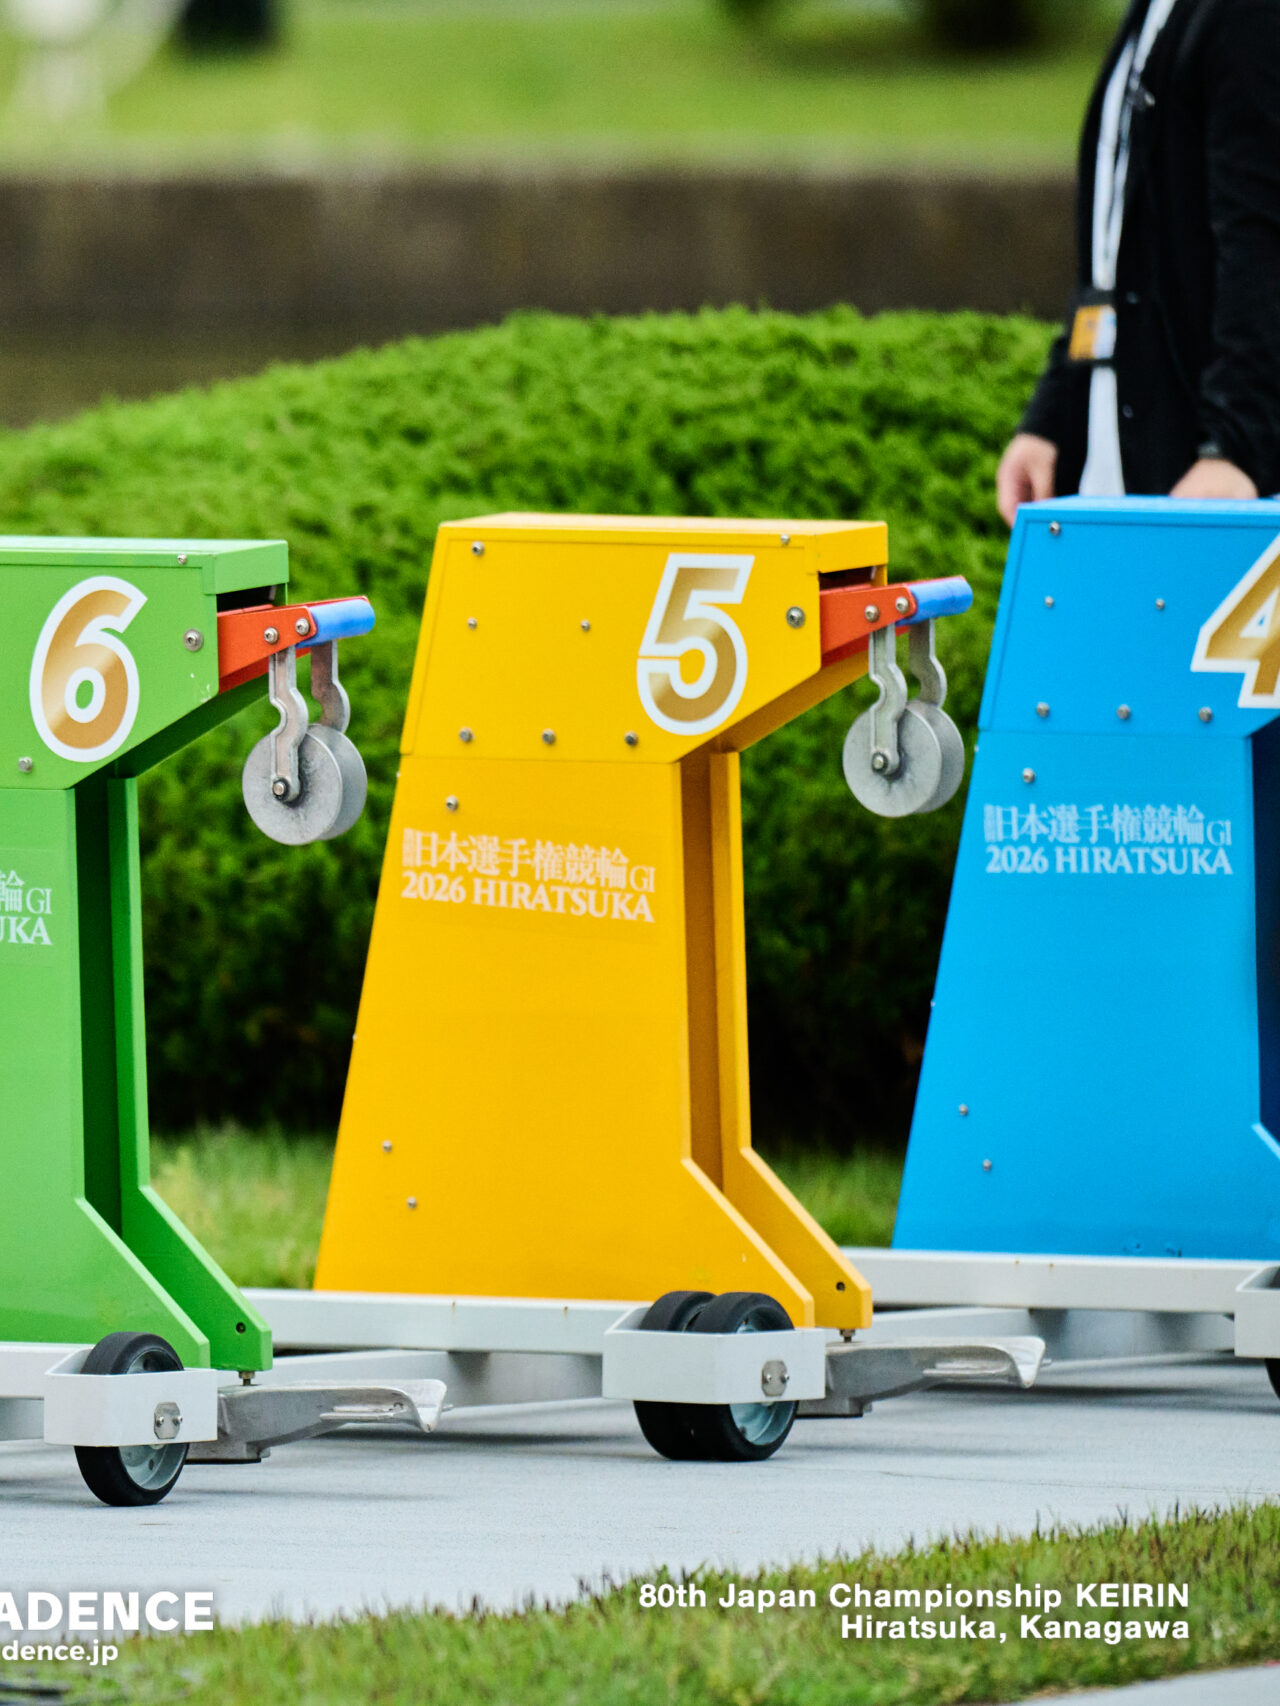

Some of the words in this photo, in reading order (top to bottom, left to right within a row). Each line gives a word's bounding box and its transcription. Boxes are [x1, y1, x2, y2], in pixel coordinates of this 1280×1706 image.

[29, 575, 148, 763] 6
[636, 553, 755, 735] 5
[1190, 531, 1280, 708] 4
[401, 870, 466, 904] 2026
[472, 877, 655, 924] HIRATSUKA
[986, 844, 1049, 874] 2026
[1055, 846, 1233, 875] HIRATSUKA
